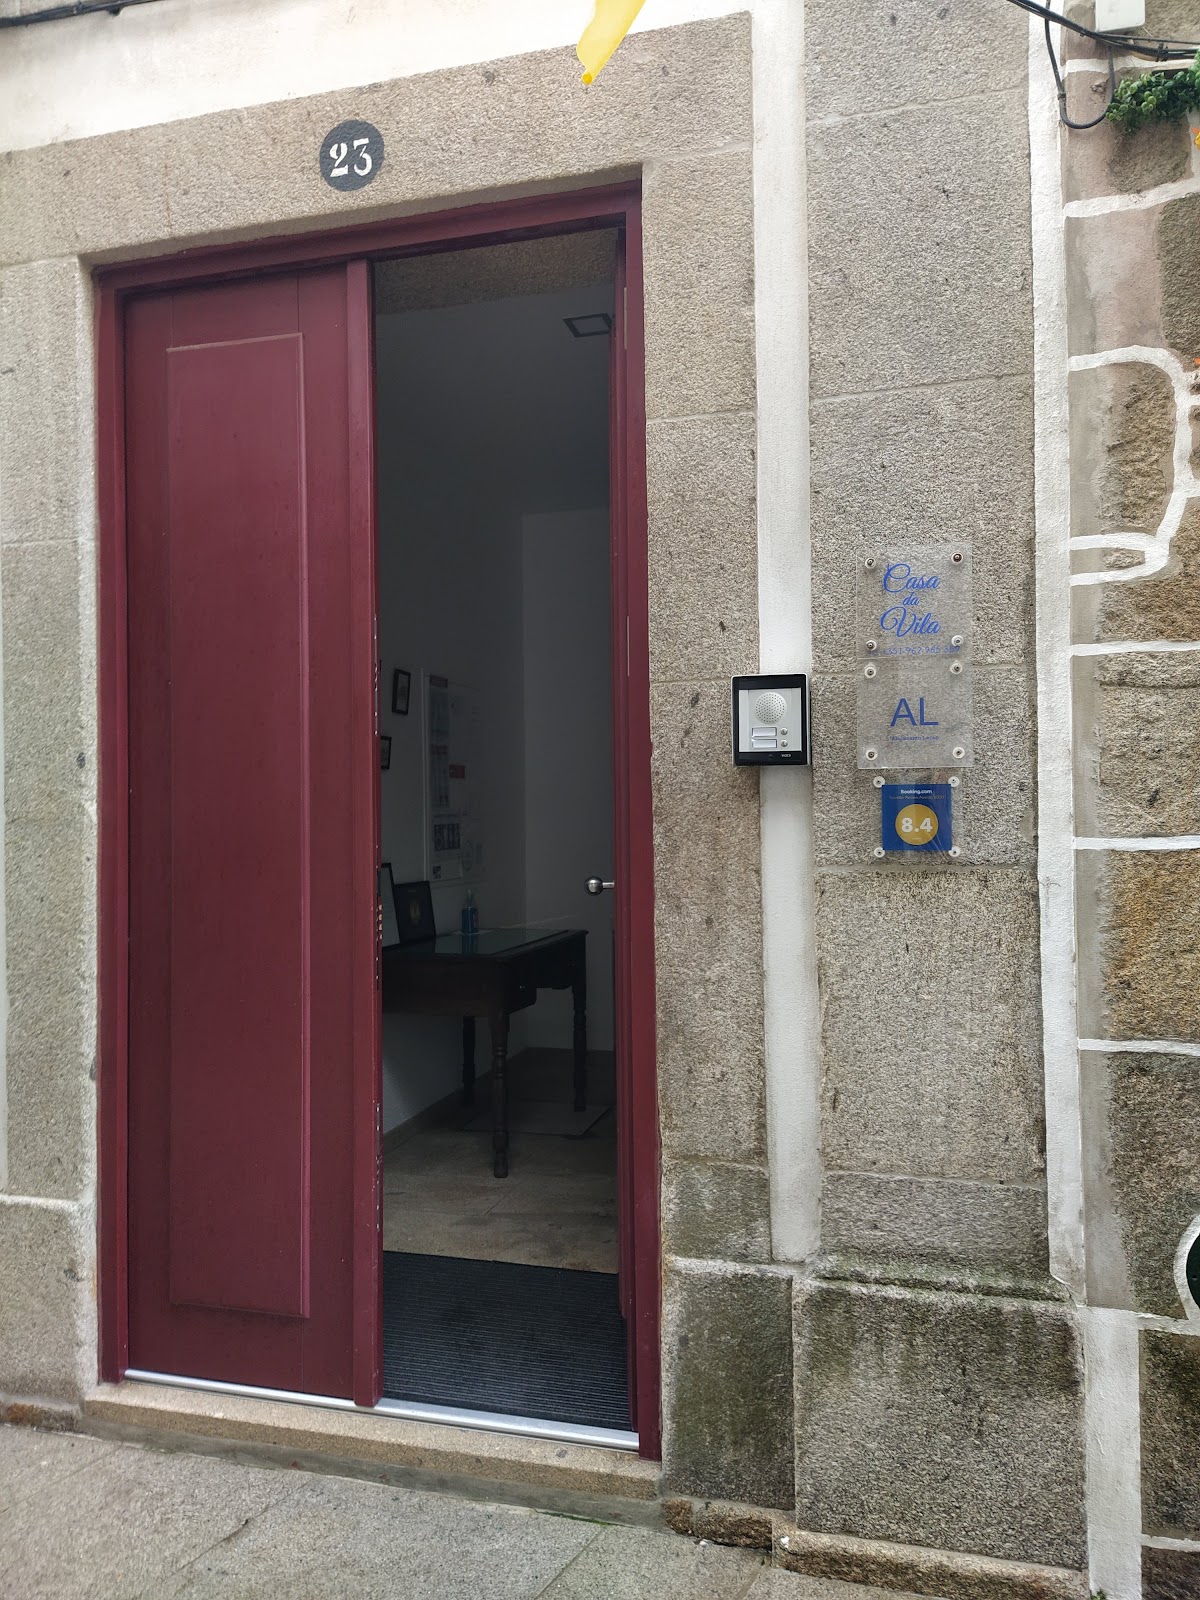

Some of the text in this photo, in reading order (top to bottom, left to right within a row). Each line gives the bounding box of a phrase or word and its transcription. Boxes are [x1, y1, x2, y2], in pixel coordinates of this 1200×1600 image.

[329, 137, 373, 178] 23
[883, 563, 941, 593] Casa
[902, 592, 920, 606] da
[880, 606, 941, 637] Vila
[890, 697, 939, 727] AL
[901, 817, 933, 833] 8.4
